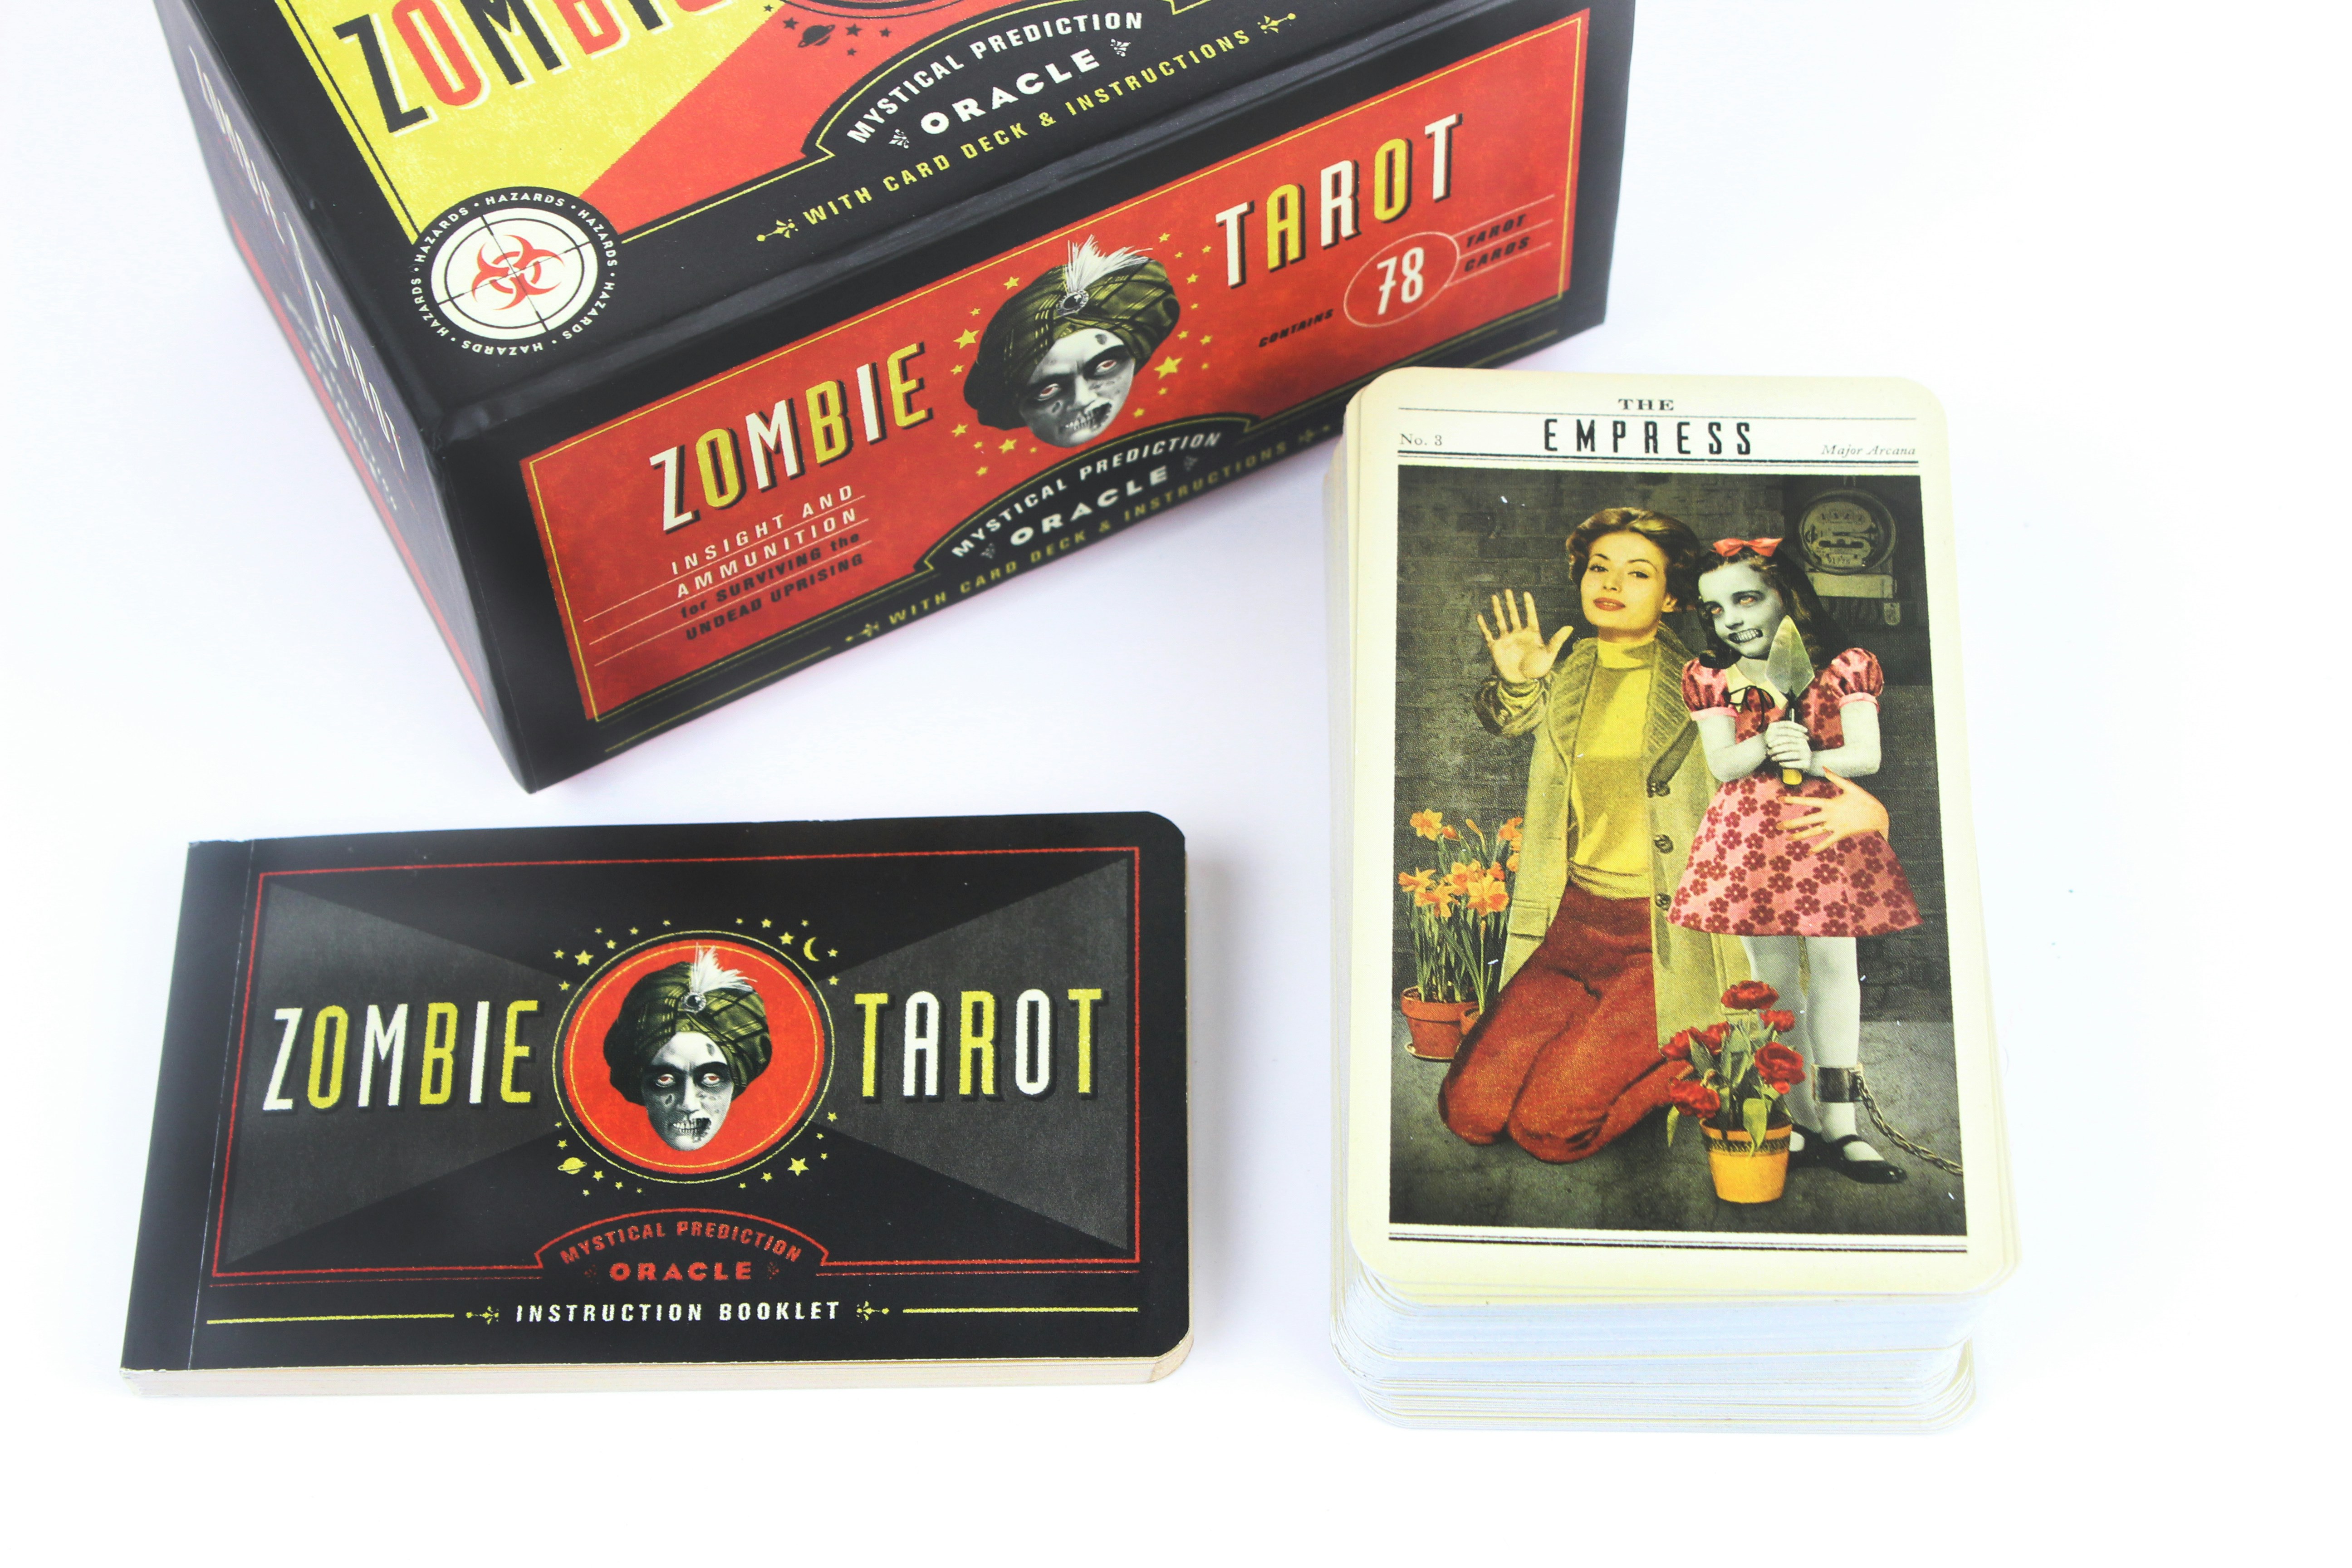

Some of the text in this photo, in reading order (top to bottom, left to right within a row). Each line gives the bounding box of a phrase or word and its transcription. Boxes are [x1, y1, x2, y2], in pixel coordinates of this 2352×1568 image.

[846, 11, 1143, 144] MYSTICAL PREDICTION
[921, 48, 1100, 135] ORACLE
[803, 29, 1250, 225] WITH CARD DECK & INSTRUCTIONS
[485, 192, 565, 207] HAZARDS
[1215, 113, 1460, 288] TAROT
[414, 207, 469, 262] HAZARDS
[577, 210, 617, 267] HAZARDS
[1464, 236, 1531, 273] CARDS
[1465, 214, 1527, 248] TAROT
[411, 277, 450, 337] HAZARDS
[562, 281, 615, 340] HAZARDS
[1377, 247, 1424, 315] 78
[461, 340, 544, 355] HAZARDS
[1258, 309, 1334, 348] CONTAINS
[1618, 399, 1674, 411] THE
[650, 343, 931, 532] ZOMBIE
[1400, 433, 1442, 446] No. 3
[1544, 418, 1750, 455] EMPRESS
[1821, 444, 1916, 458] Major Arcana
[951, 431, 1221, 558] MYSTICAL PREDICTION
[1010, 465, 1168, 546] ORACLE
[671, 485, 853, 575] INSIGHT AND
[677, 508, 856, 598] AMMUNITION
[889, 441, 1286, 625] WITH CARD DECK & INSTRUCTIONS
[681, 533, 860, 619] for SURVIVING the
[686, 553, 863, 640] UNDEAD UPRISING
[263, 989, 1102, 1111] ZOMBIE TAROT
[560, 1220, 801, 1264] MYSTICAL PREDICTION
[610, 1261, 751, 1281] ORACLE
[516, 1301, 840, 1322] INSTRUCTION BOOKLET
